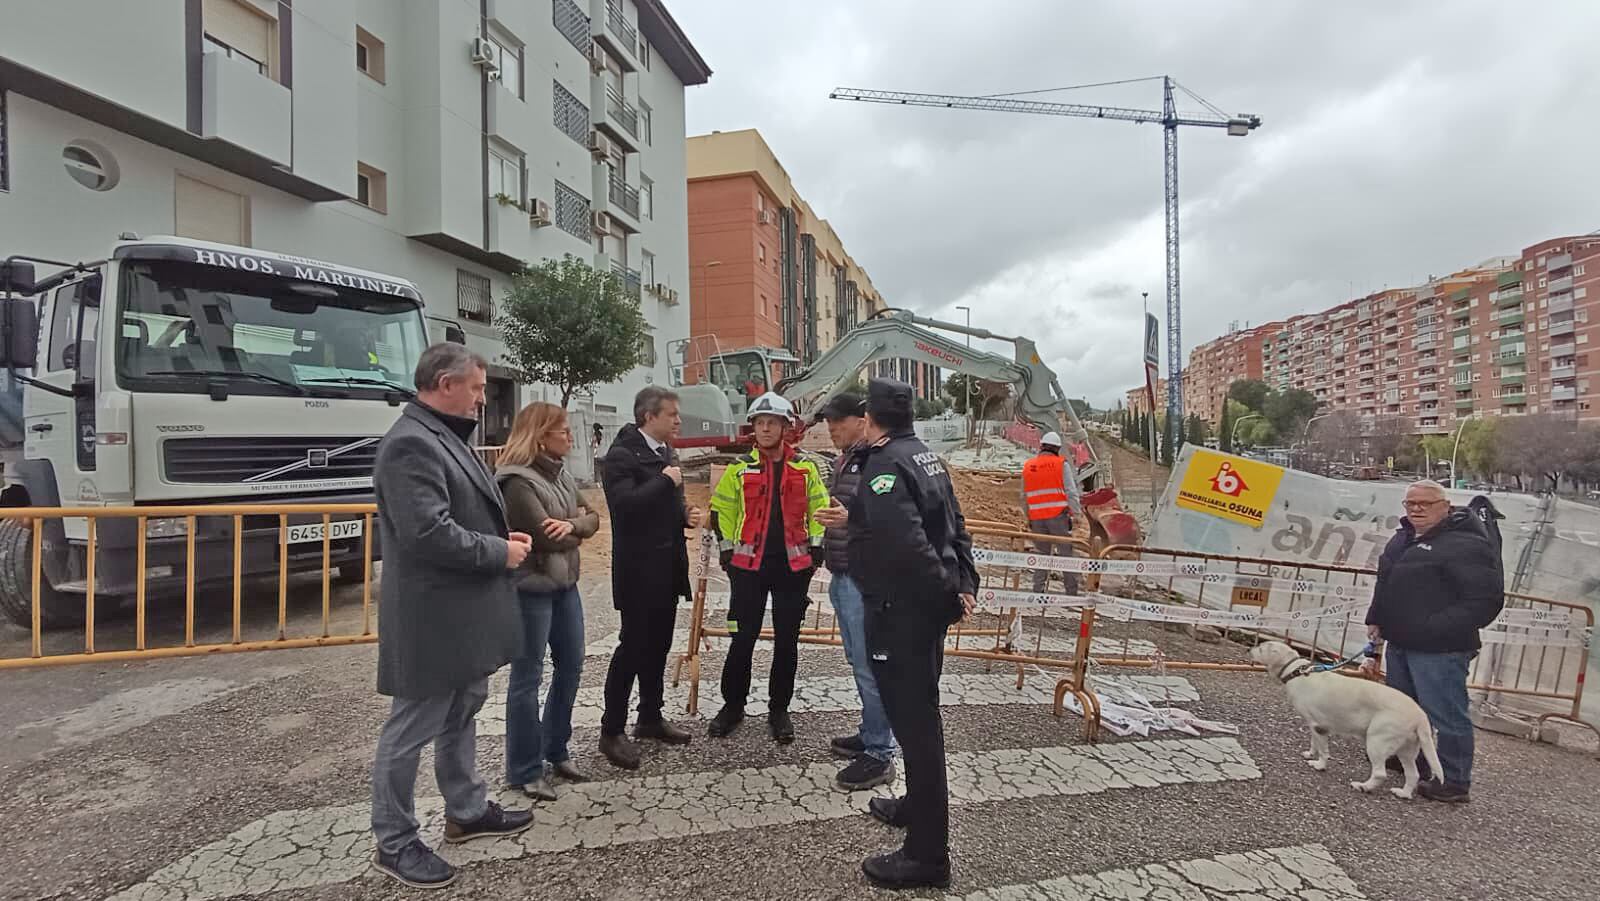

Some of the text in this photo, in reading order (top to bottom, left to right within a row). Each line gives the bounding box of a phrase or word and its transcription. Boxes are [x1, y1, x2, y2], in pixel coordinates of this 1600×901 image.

[193, 249, 282, 276] HNOS.
[294, 264, 405, 297] MARTINEZ
[156, 424, 205, 433] VOLVO
[1179, 490, 1263, 519] INMOBILIARIA OSUNA
[333, 522, 359, 537] DVP
[1240, 590, 1264, 602] LOCAL
